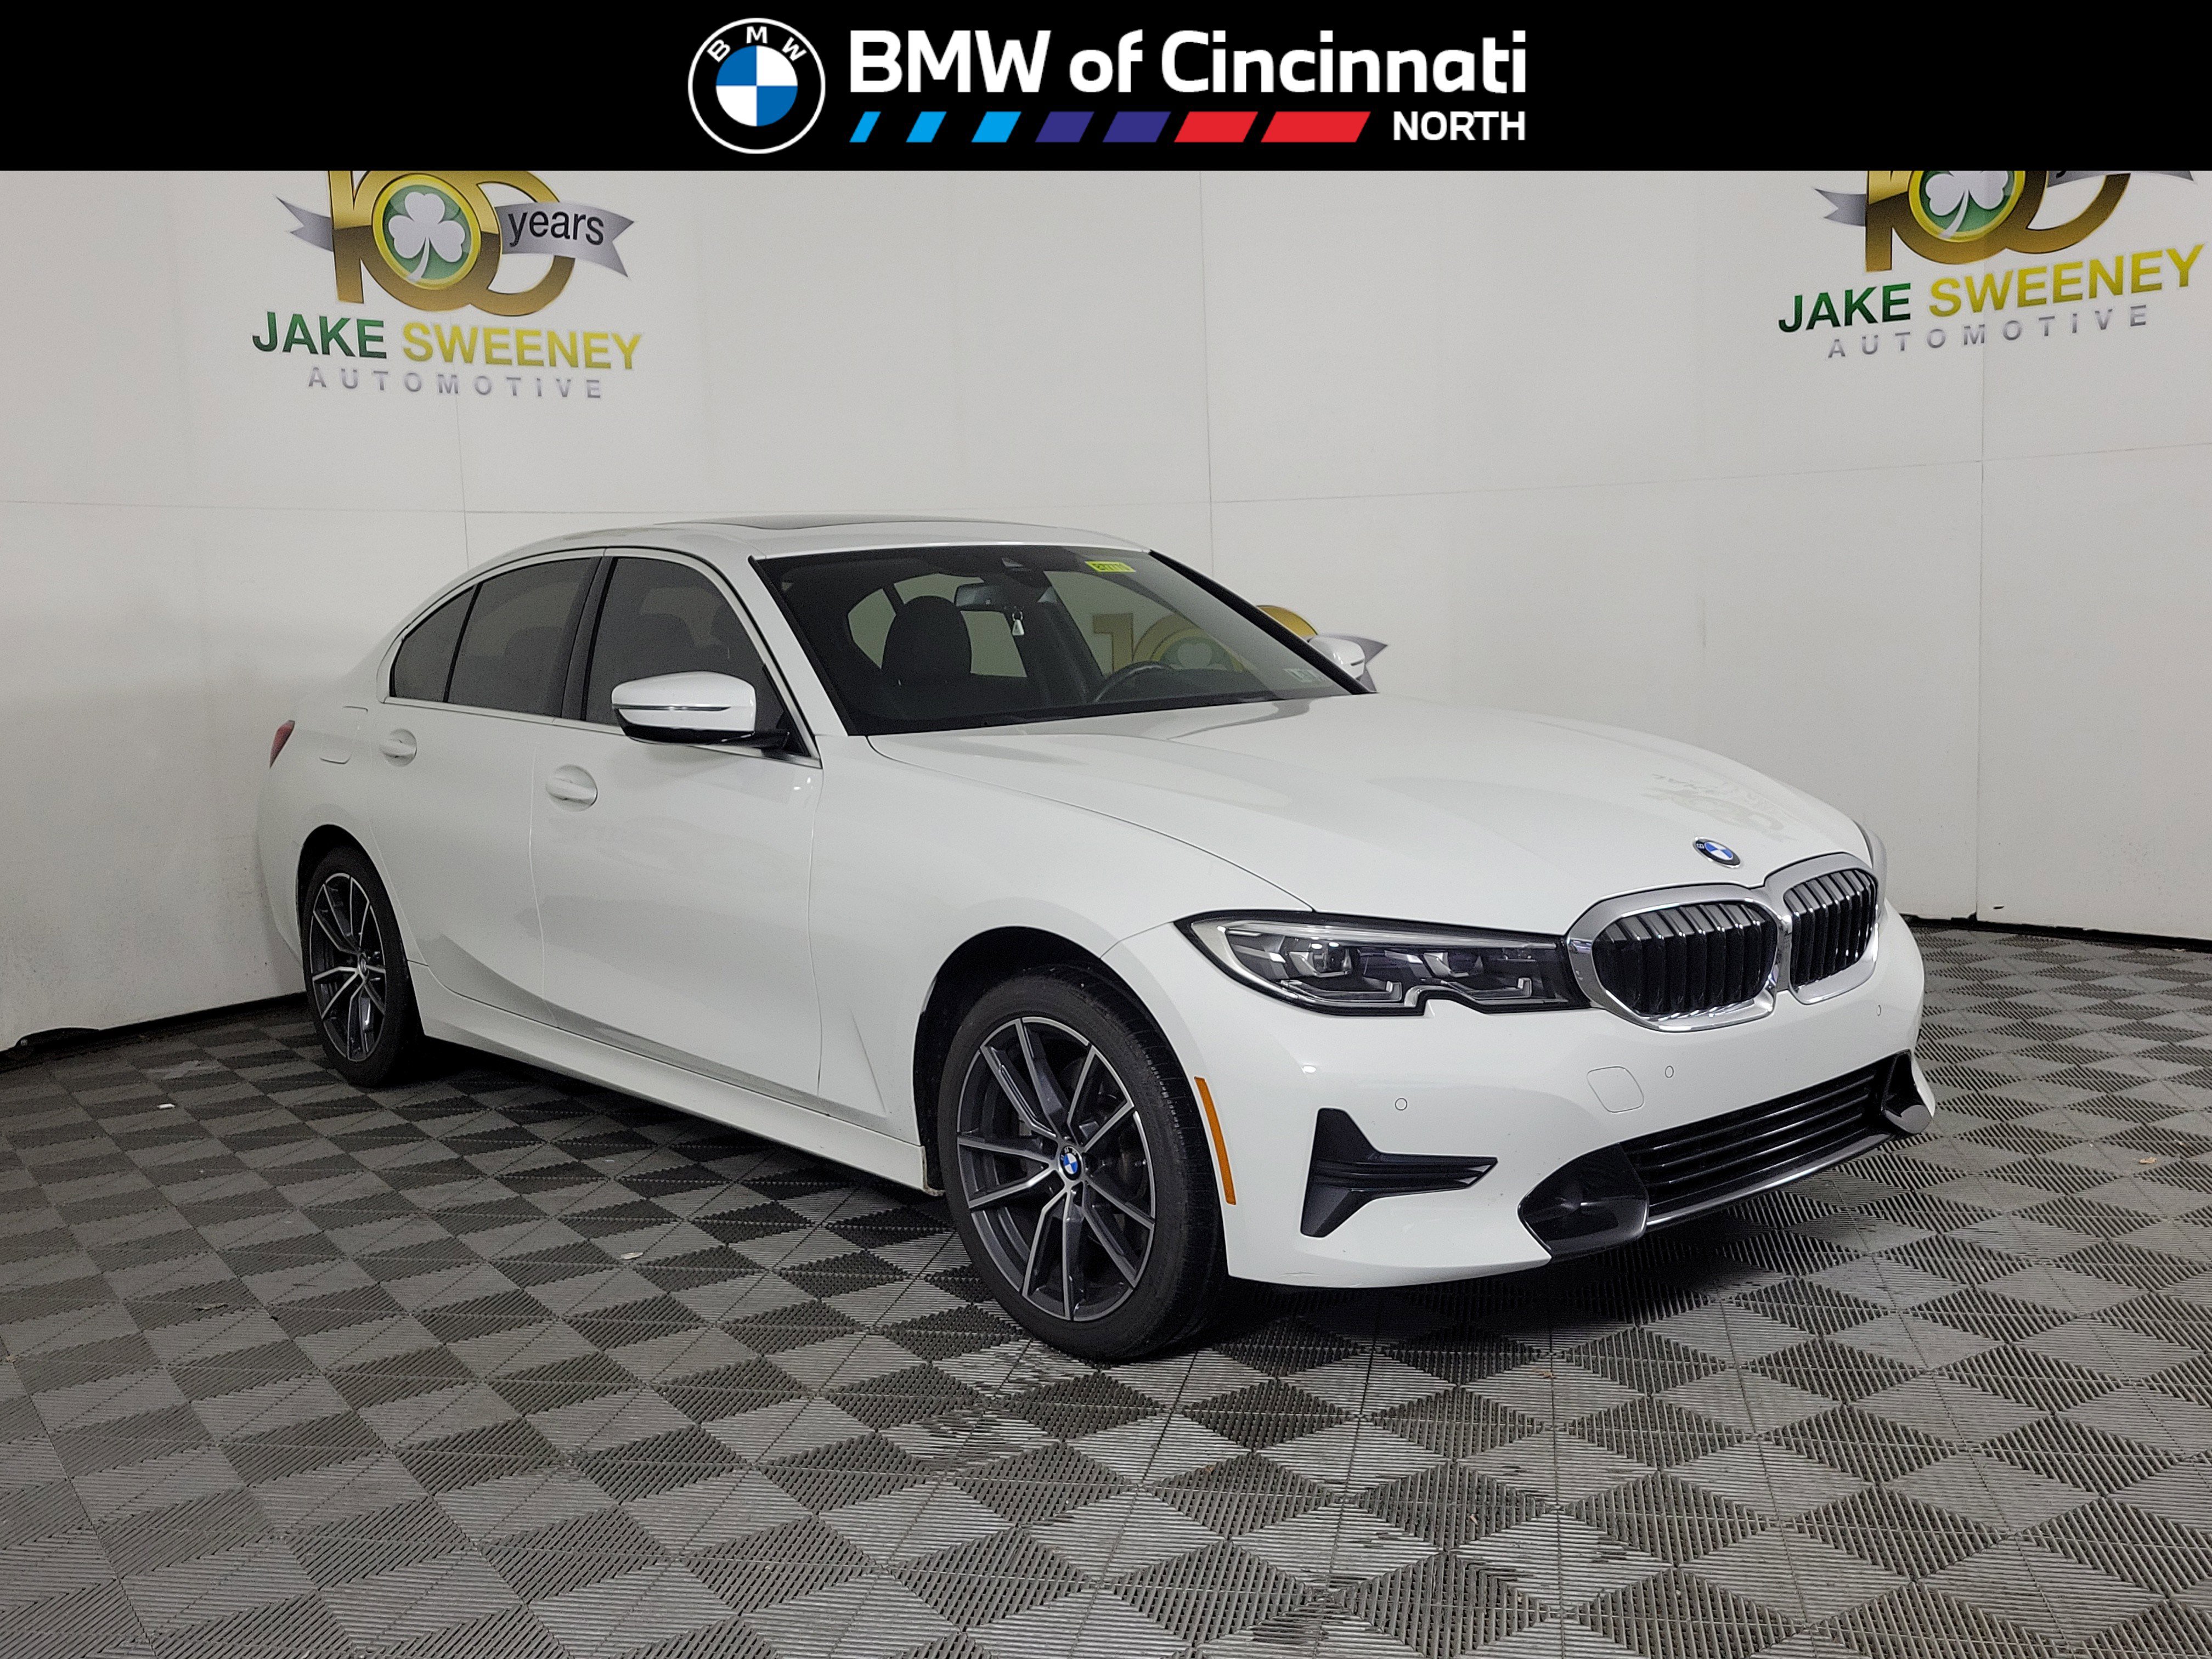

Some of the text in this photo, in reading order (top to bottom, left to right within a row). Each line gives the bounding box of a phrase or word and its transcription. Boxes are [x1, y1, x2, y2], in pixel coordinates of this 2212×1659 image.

[507, 210, 605, 249] years
[1778, 242, 2206, 334] JAKE SWEENEY
[251, 311, 642, 371] JAKE SWEENEY
[1827, 304, 2148, 359] AUTOMOTIVE
[308, 366, 602, 399] AUTOMOTIVE
